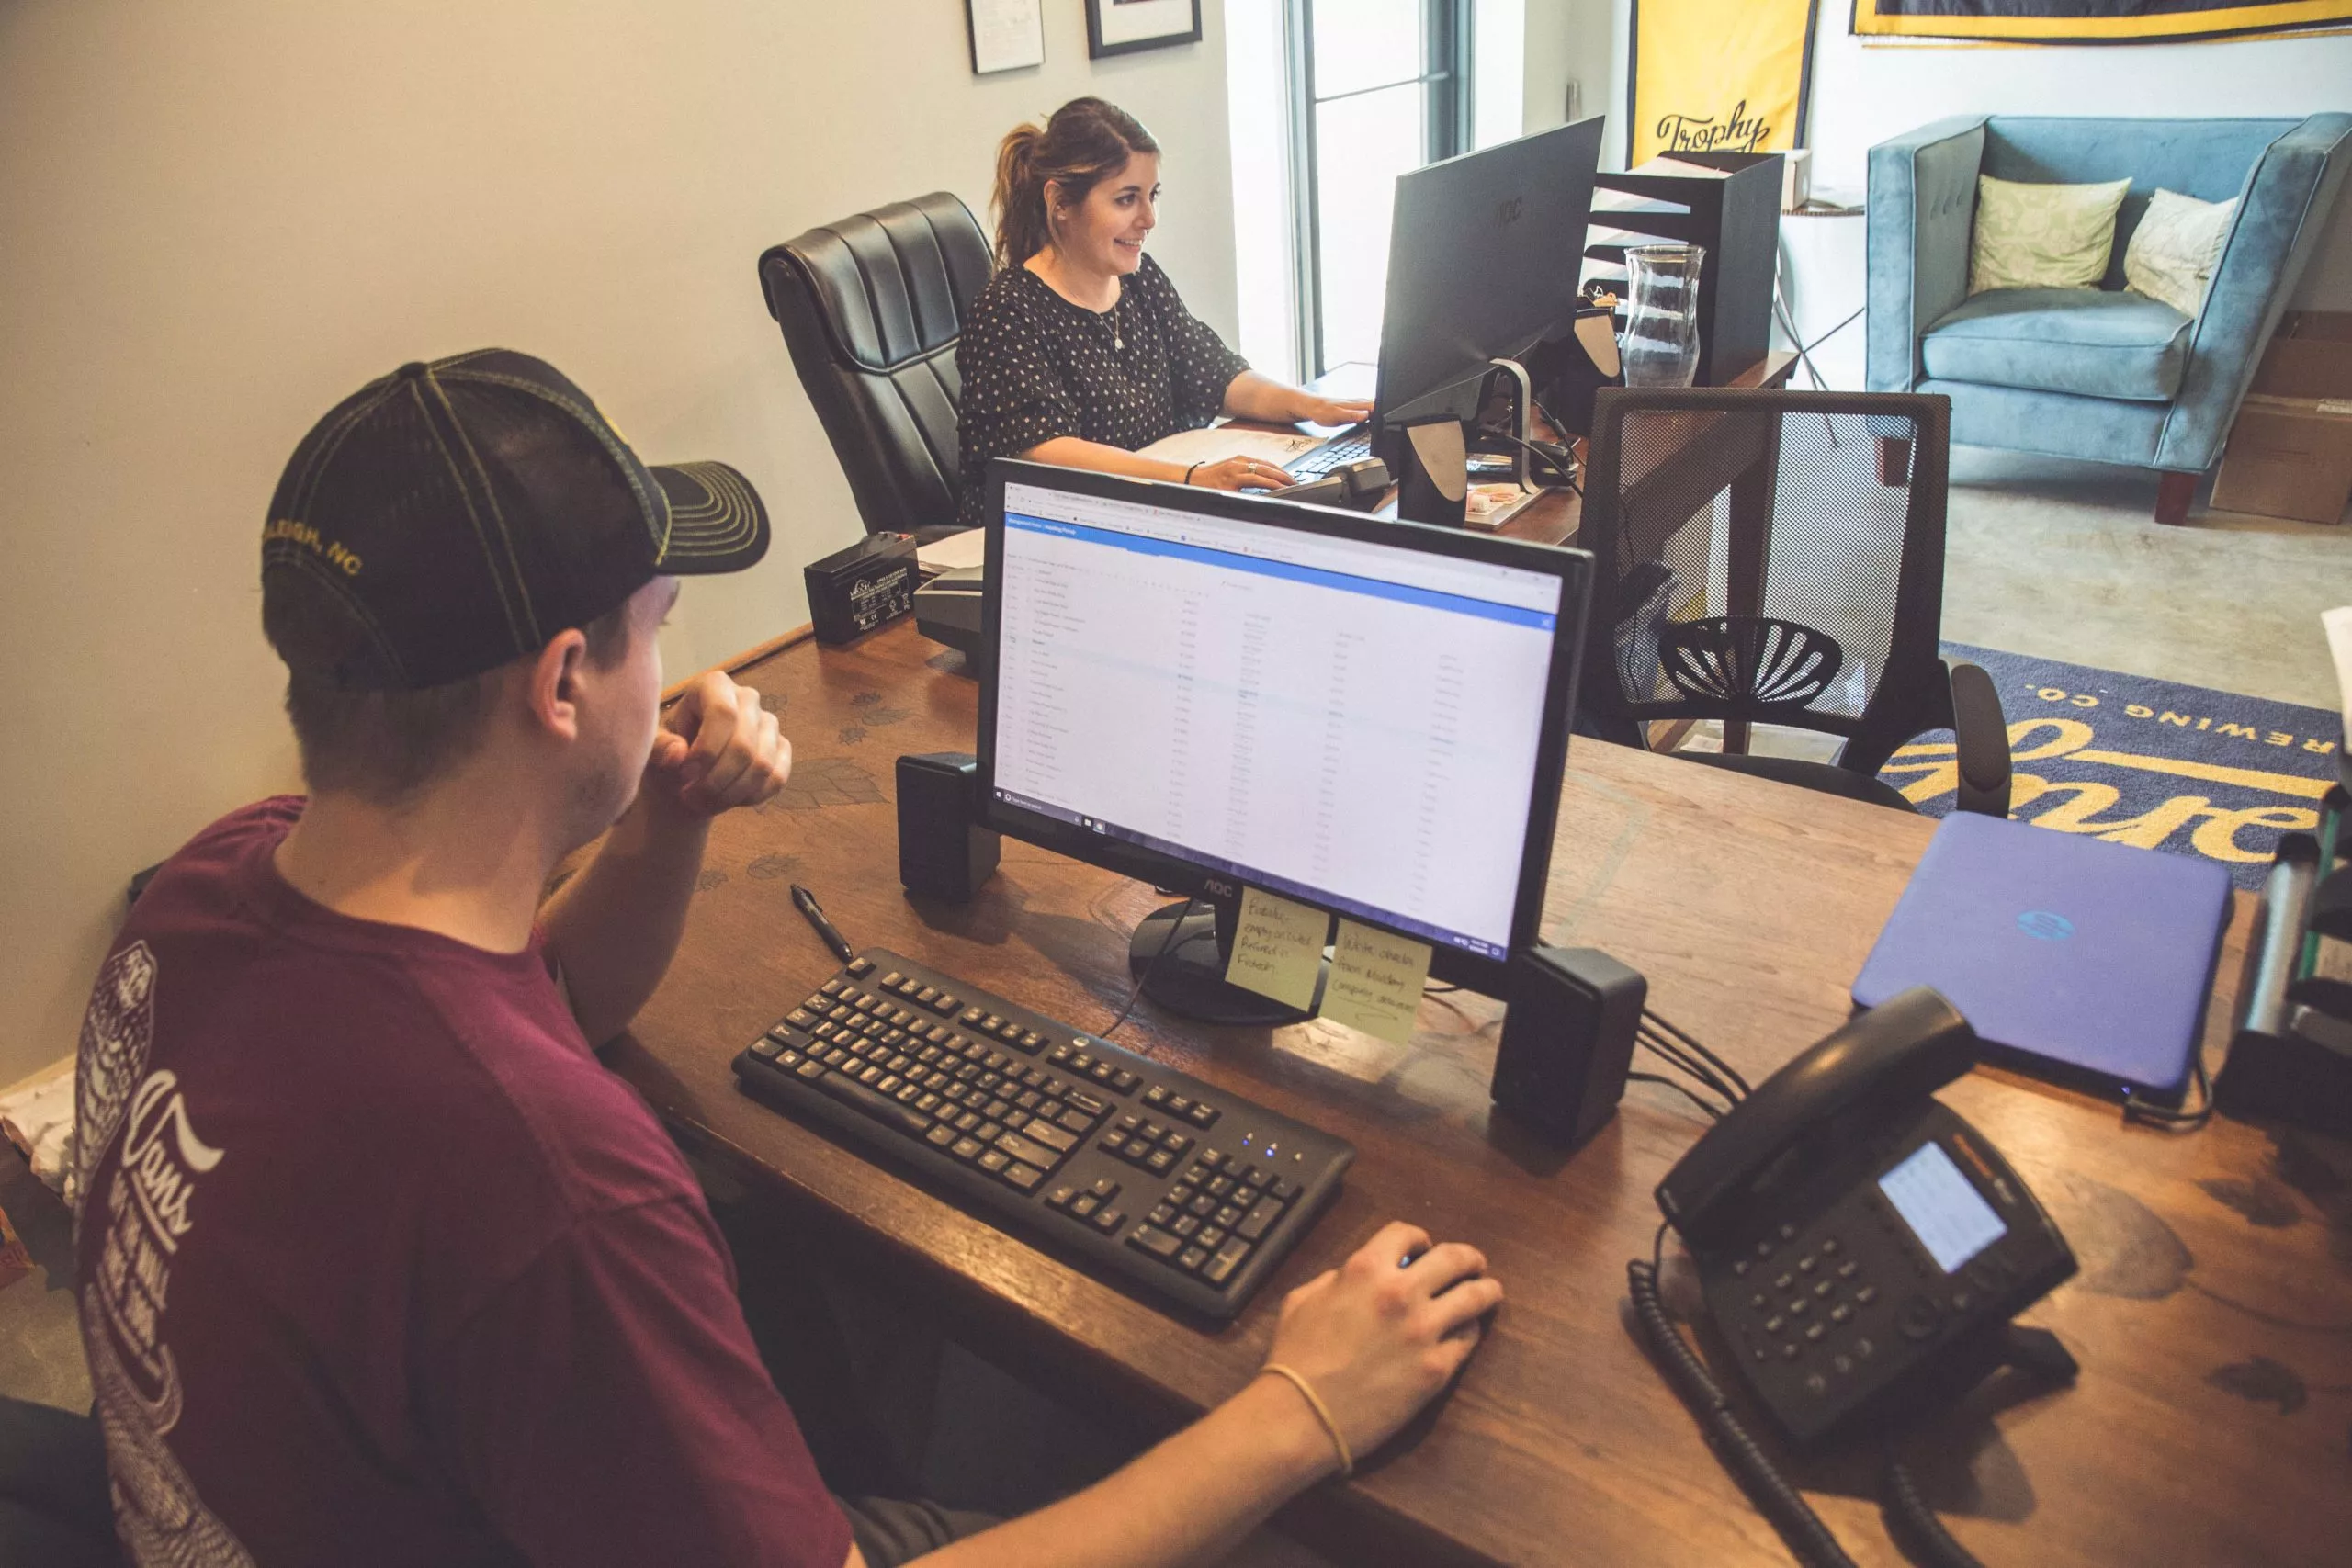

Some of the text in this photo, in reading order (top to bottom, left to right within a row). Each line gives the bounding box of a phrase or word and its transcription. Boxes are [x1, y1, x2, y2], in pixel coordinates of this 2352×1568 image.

[1657, 99, 1771, 153] Trophy
[2024, 682, 2338, 755] REWING CO.
